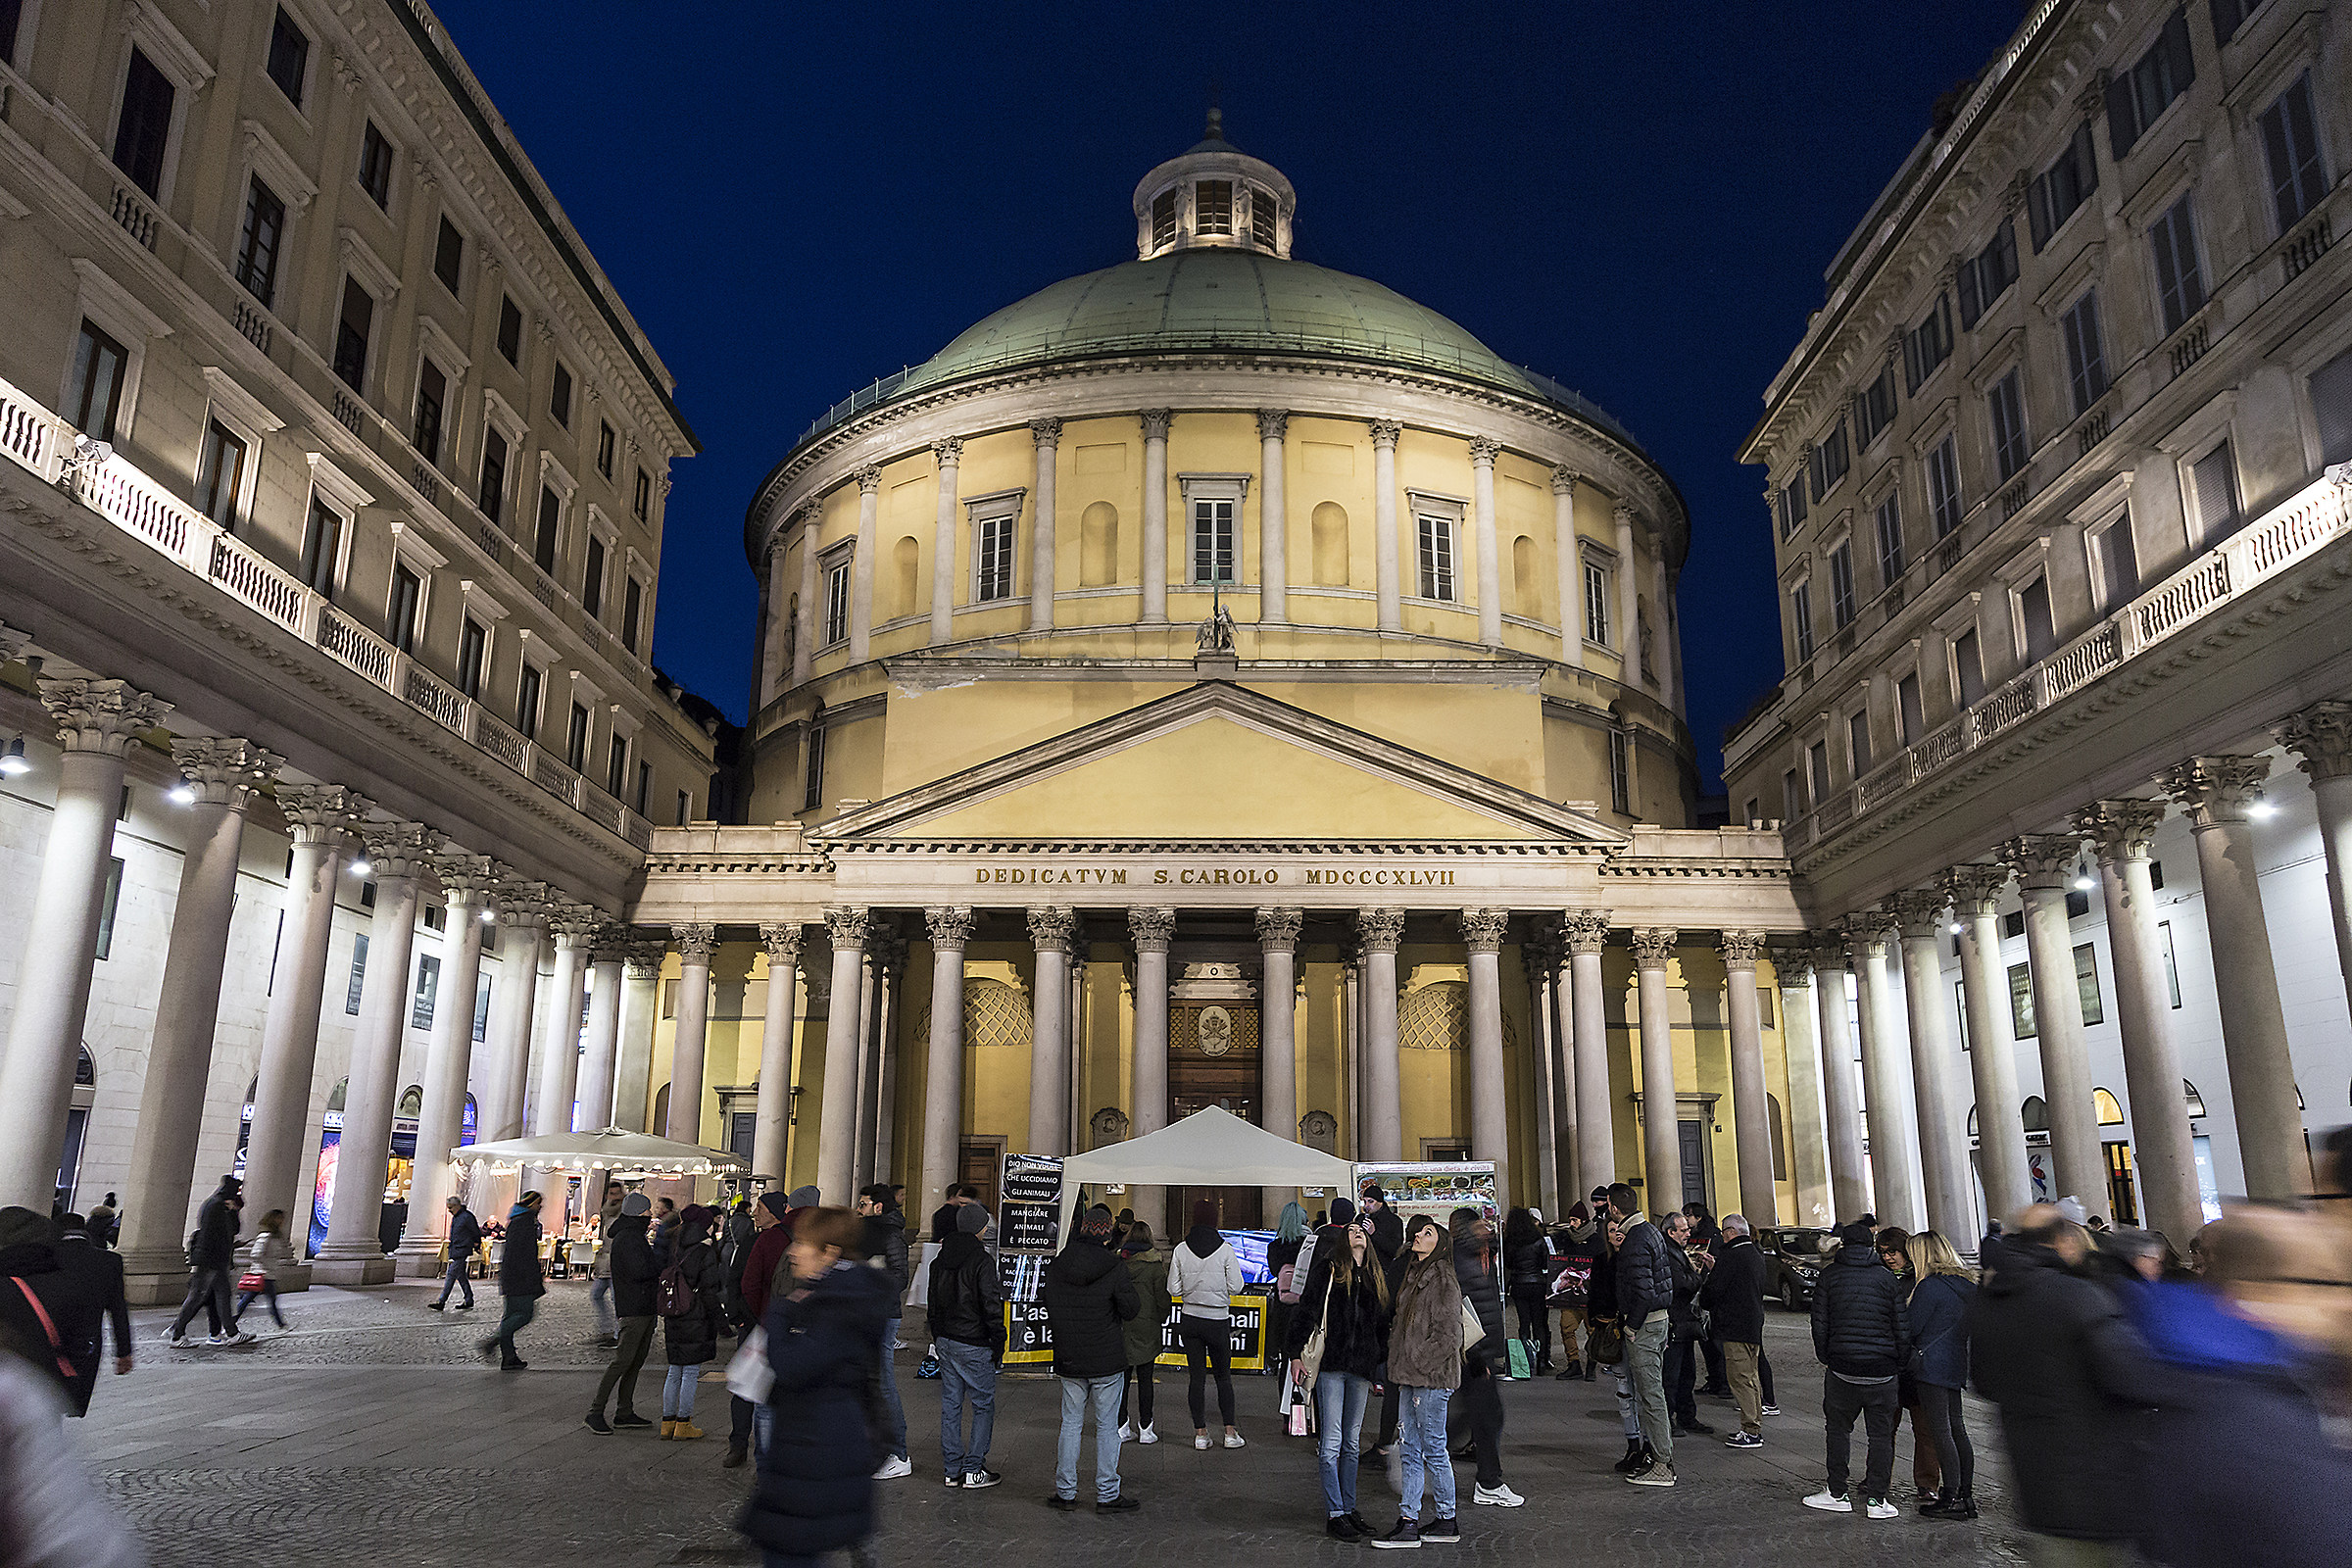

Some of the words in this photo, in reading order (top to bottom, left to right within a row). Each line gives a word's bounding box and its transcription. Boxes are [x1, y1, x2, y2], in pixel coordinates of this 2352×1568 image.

[975, 868, 1127, 884] DEDICATVM
[1305, 869, 1455, 885] MDCCCXLVII
[1020, 1175, 1058, 1184] UCCIDIAMO
[1010, 1209, 1049, 1218] MANGIARE
[1017, 1237, 1049, 1246] PECCATO
[1023, 1326, 1036, 1344] è
